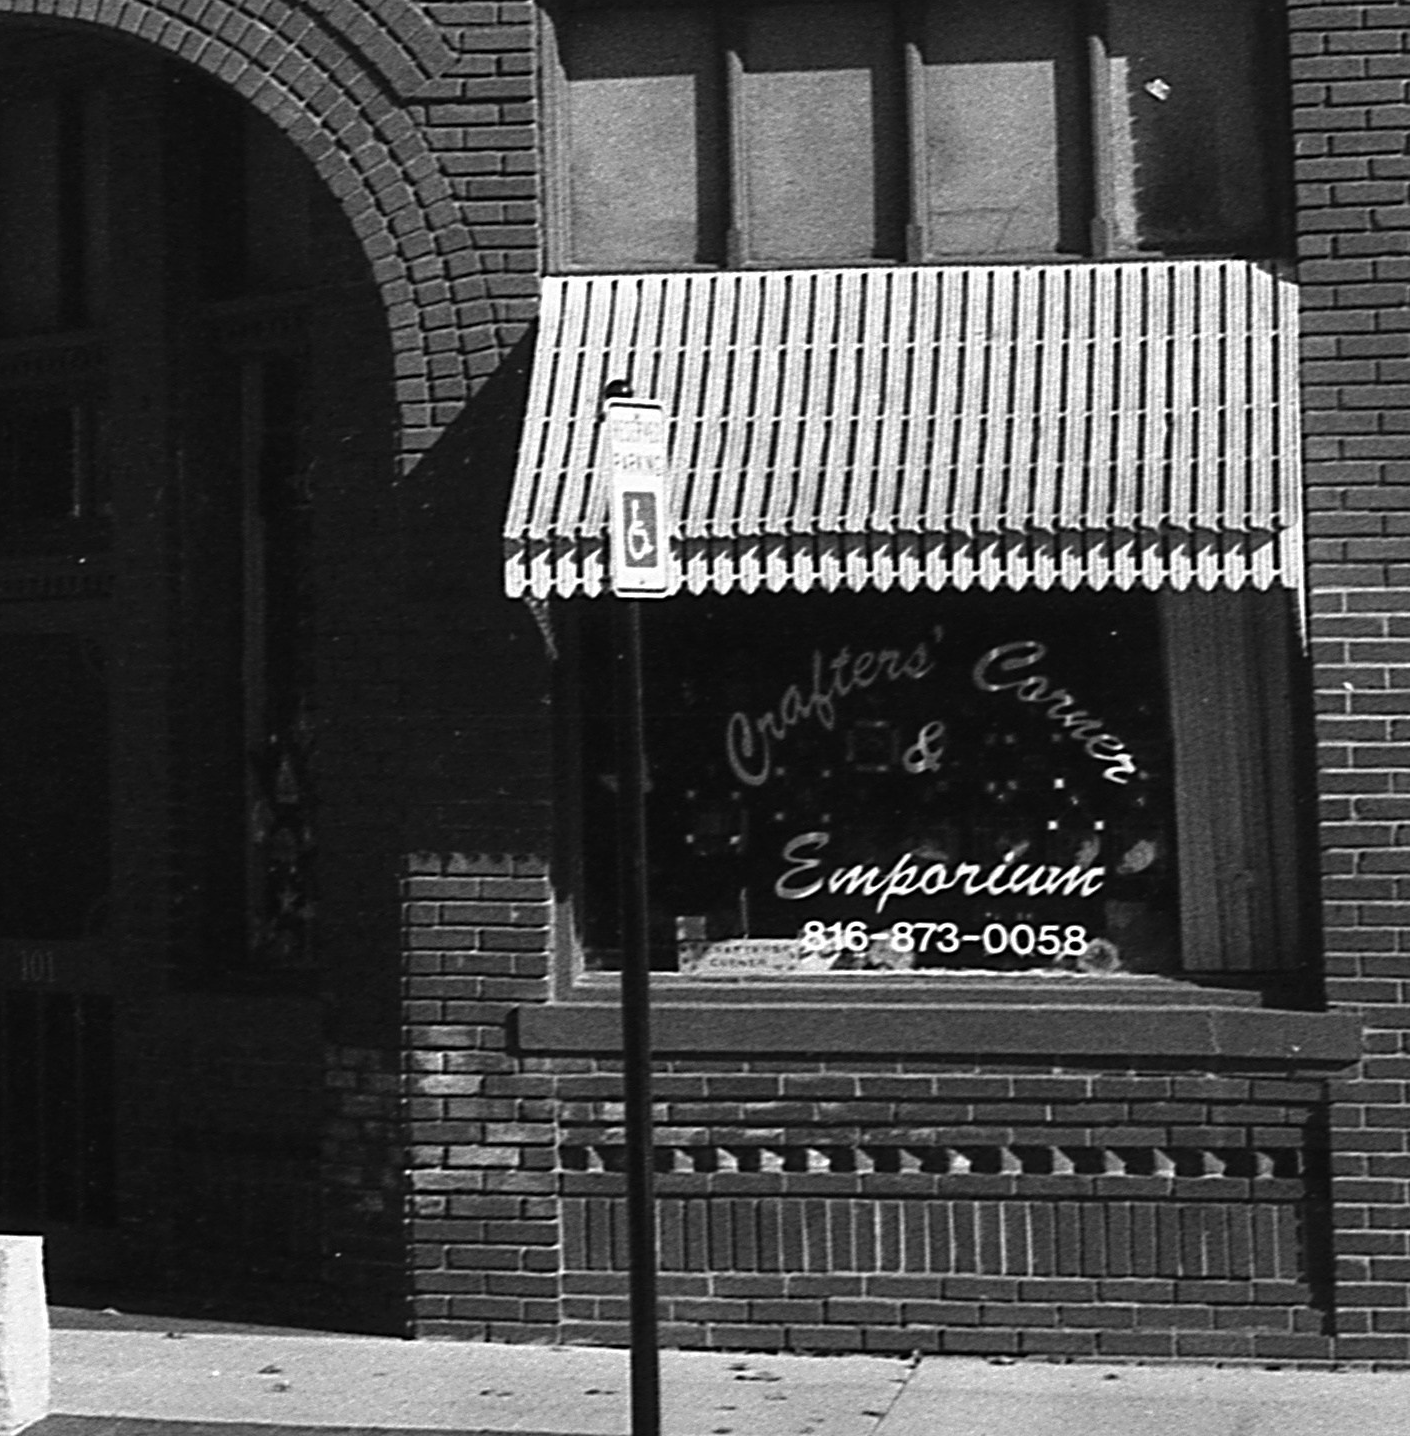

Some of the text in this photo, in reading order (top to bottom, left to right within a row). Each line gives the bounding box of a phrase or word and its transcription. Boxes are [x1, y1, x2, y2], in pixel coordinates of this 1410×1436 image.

[726, 624, 1137, 786] Crafters' Corner
[902, 720, 946, 774] &
[774, 831, 1106, 914] Emporium
[801, 920, 1090, 956] 816-873-0058
[20, 949, 56, 983] 101
